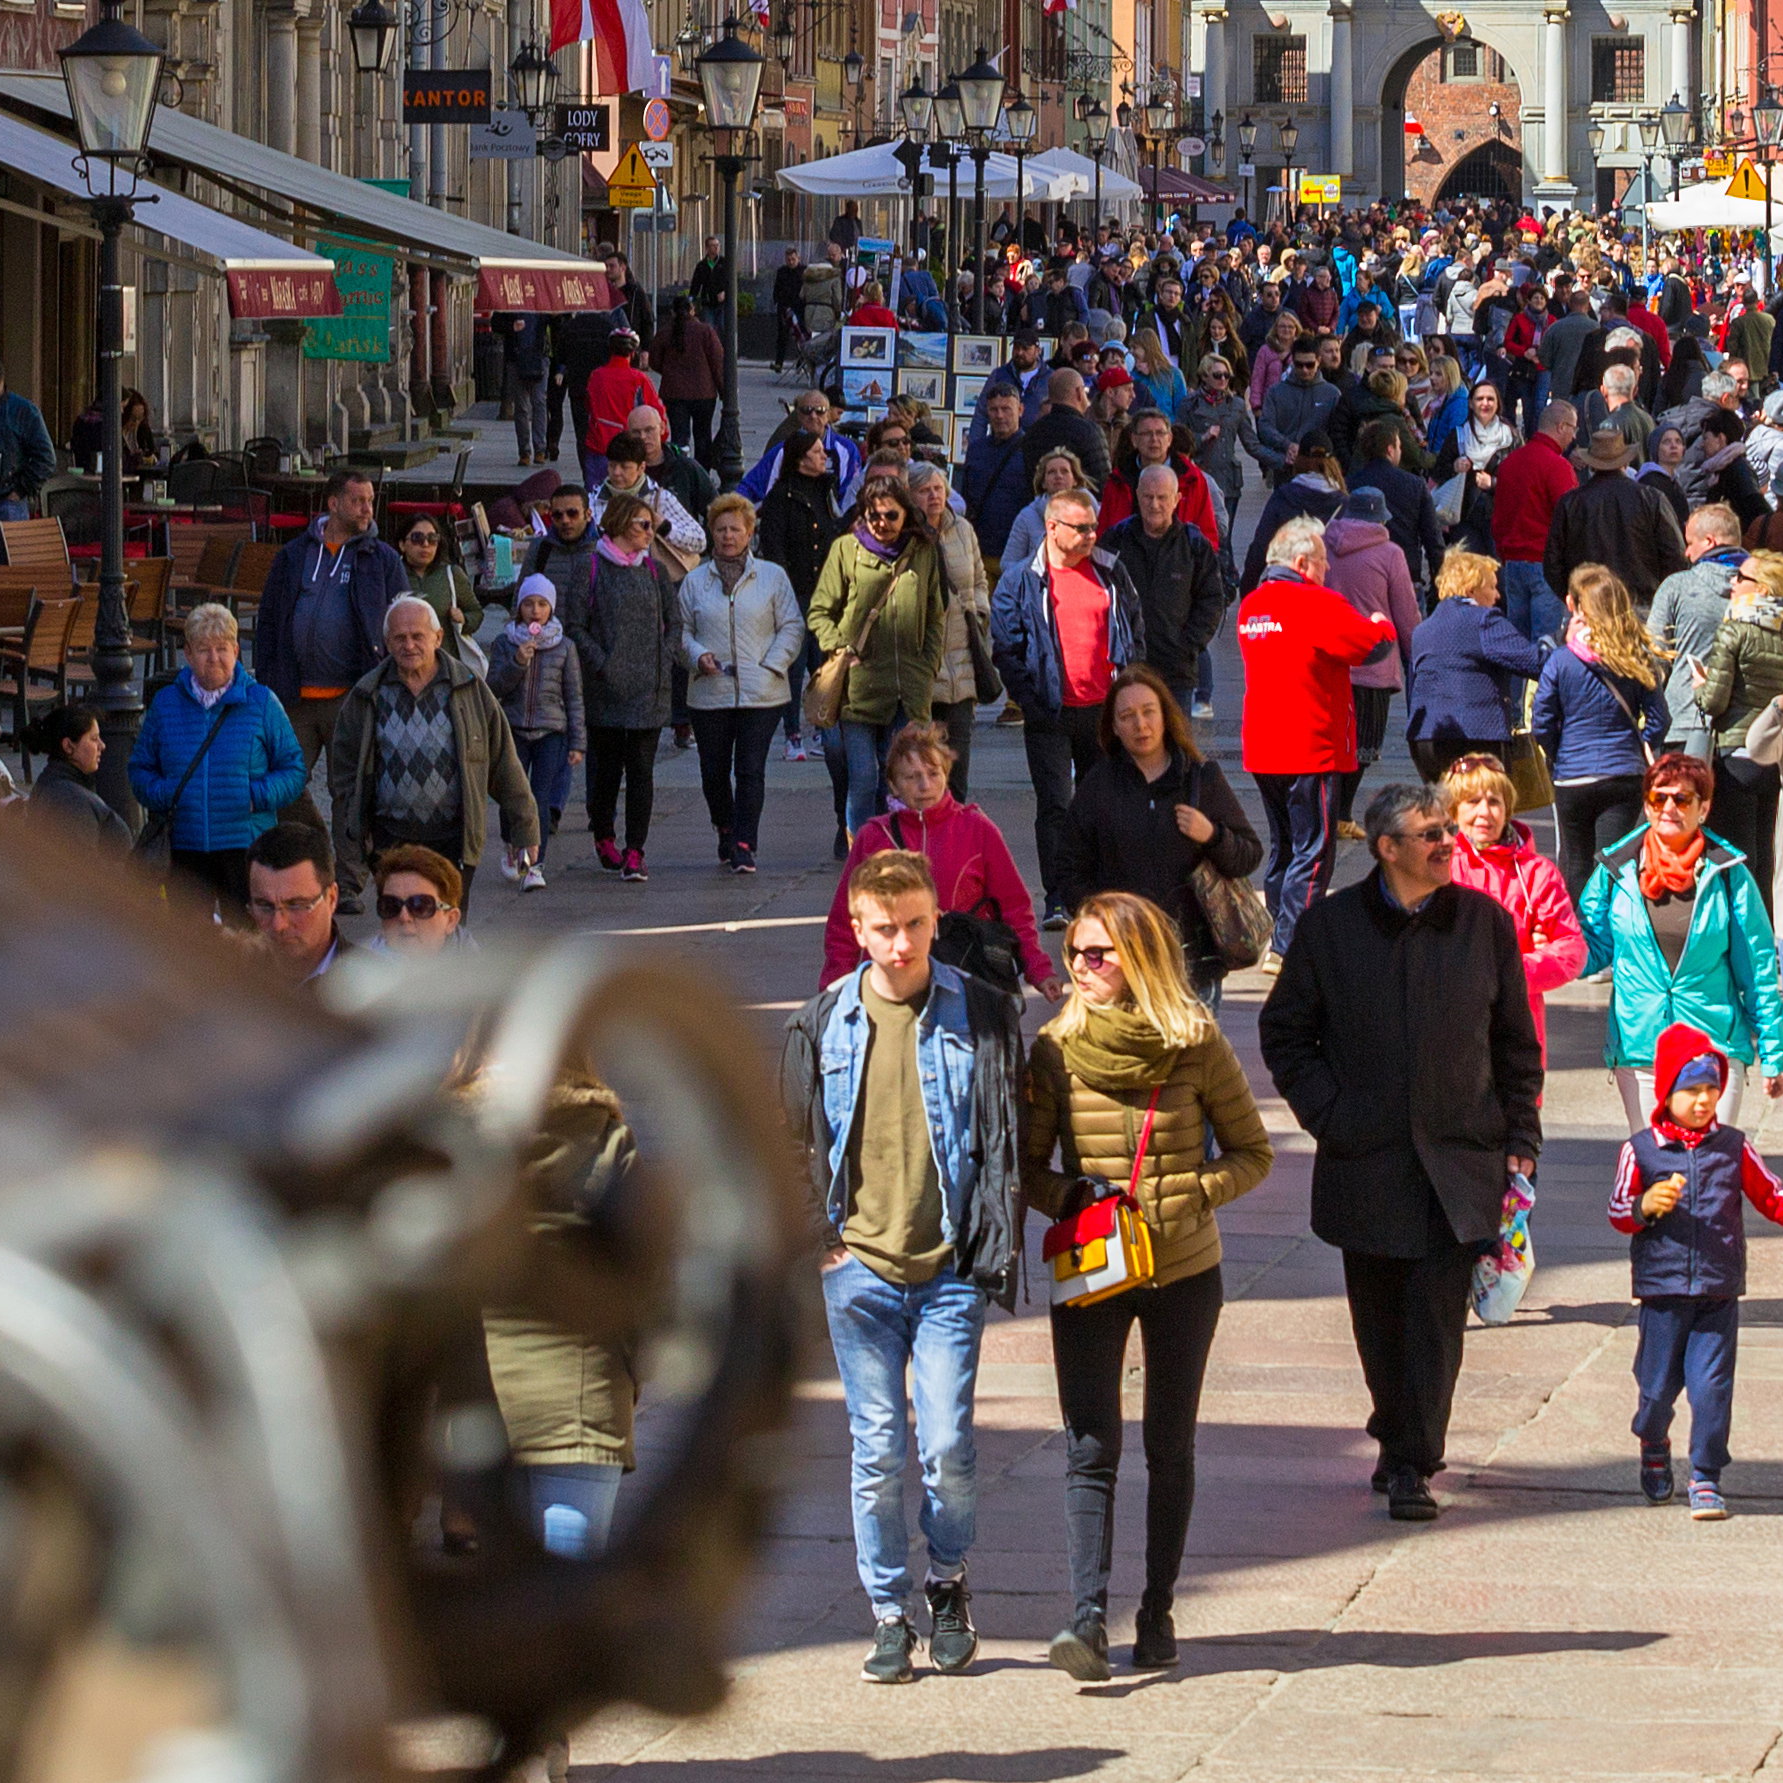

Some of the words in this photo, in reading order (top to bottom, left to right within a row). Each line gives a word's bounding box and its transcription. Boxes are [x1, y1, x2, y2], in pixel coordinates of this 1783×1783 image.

[403, 89, 486, 106] KANTOR
[568, 110, 598, 127] LODY
[491, 143, 530, 153] Pocztowy
[334, 259, 379, 277] lass
